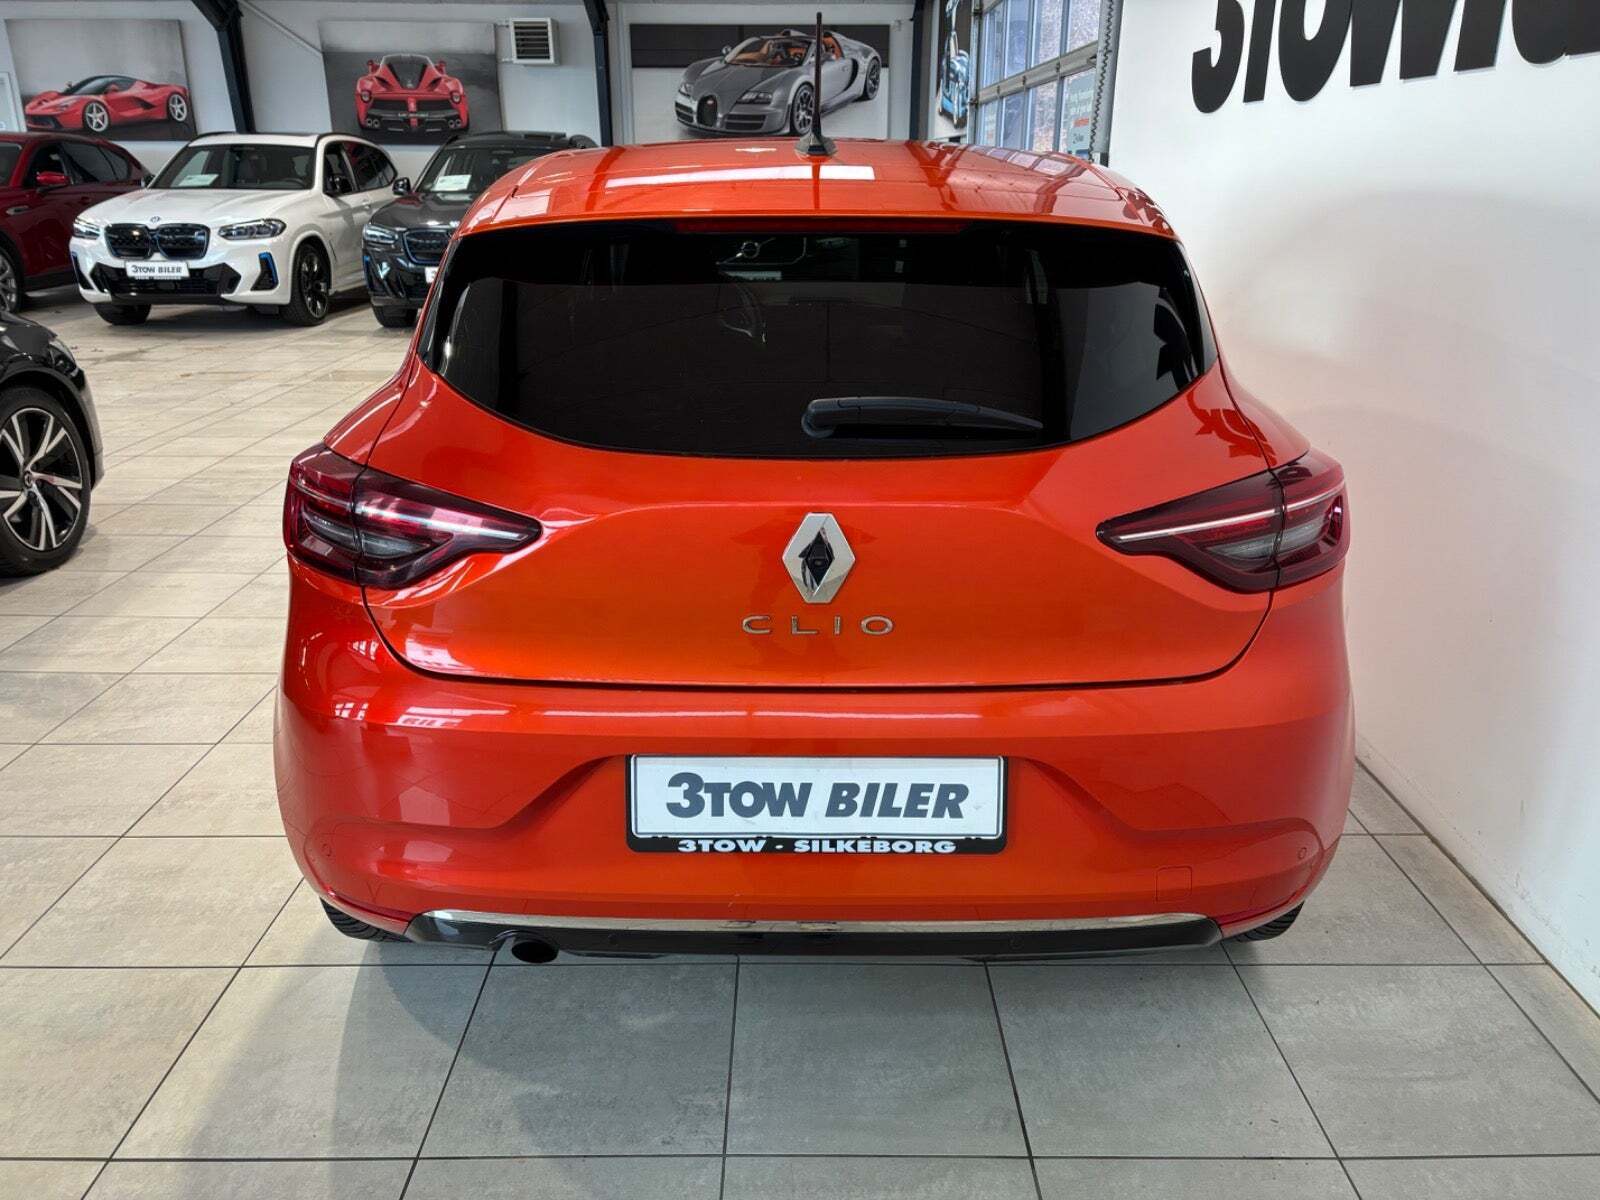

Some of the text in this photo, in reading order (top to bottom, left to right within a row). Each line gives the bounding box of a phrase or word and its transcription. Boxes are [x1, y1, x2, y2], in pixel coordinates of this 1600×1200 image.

[131, 264, 156, 273] 3TOW
[742, 615, 894, 635] CLIO
[666, 771, 970, 819] 3TOW BILER
[677, 839, 767, 853] 3TOW
[793, 839, 957, 853] SILKEBORG
